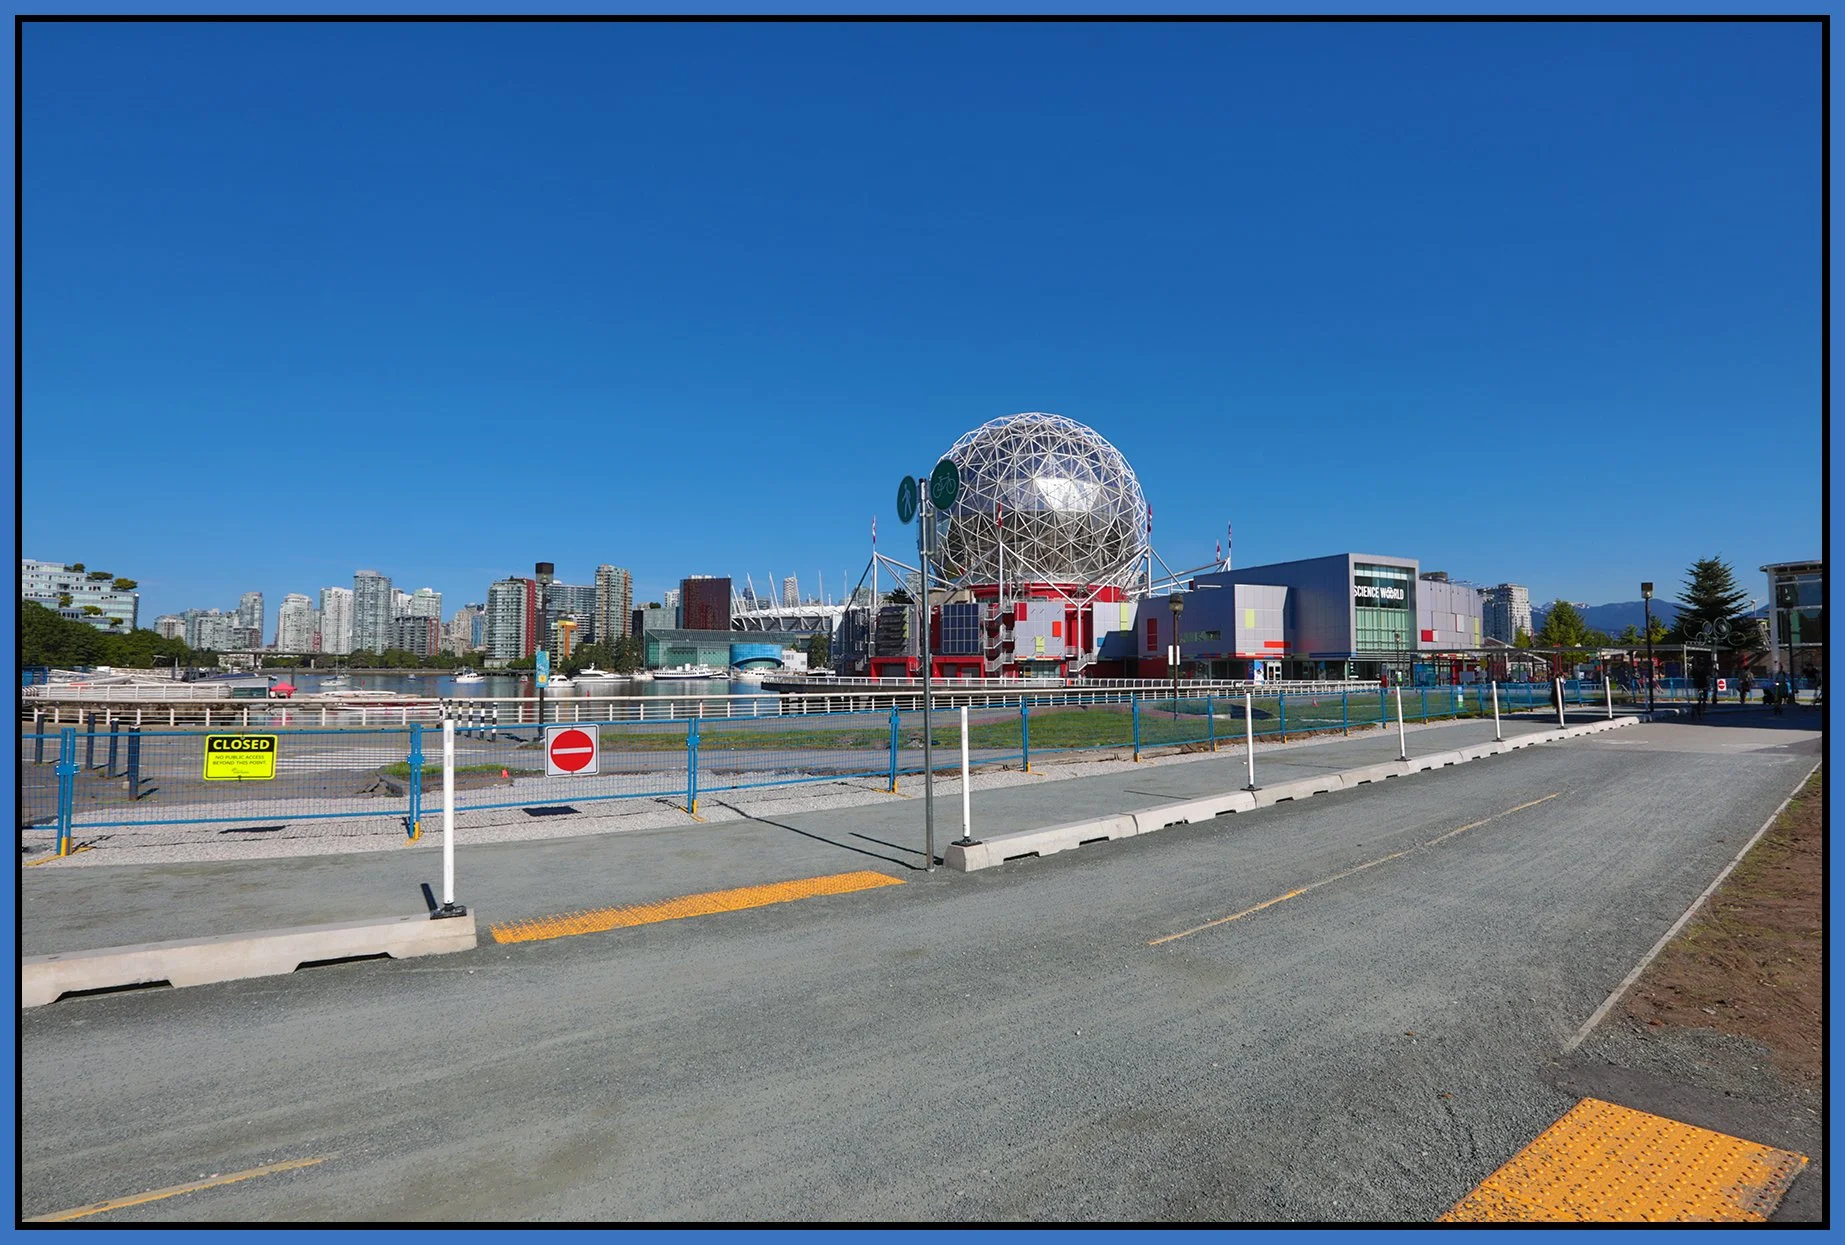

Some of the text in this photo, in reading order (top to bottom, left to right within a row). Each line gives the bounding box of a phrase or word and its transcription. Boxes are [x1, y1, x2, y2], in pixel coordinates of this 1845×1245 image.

[1354, 585, 1404, 600] SCIENCE WORLD
[213, 739, 270, 750] CLOSED
